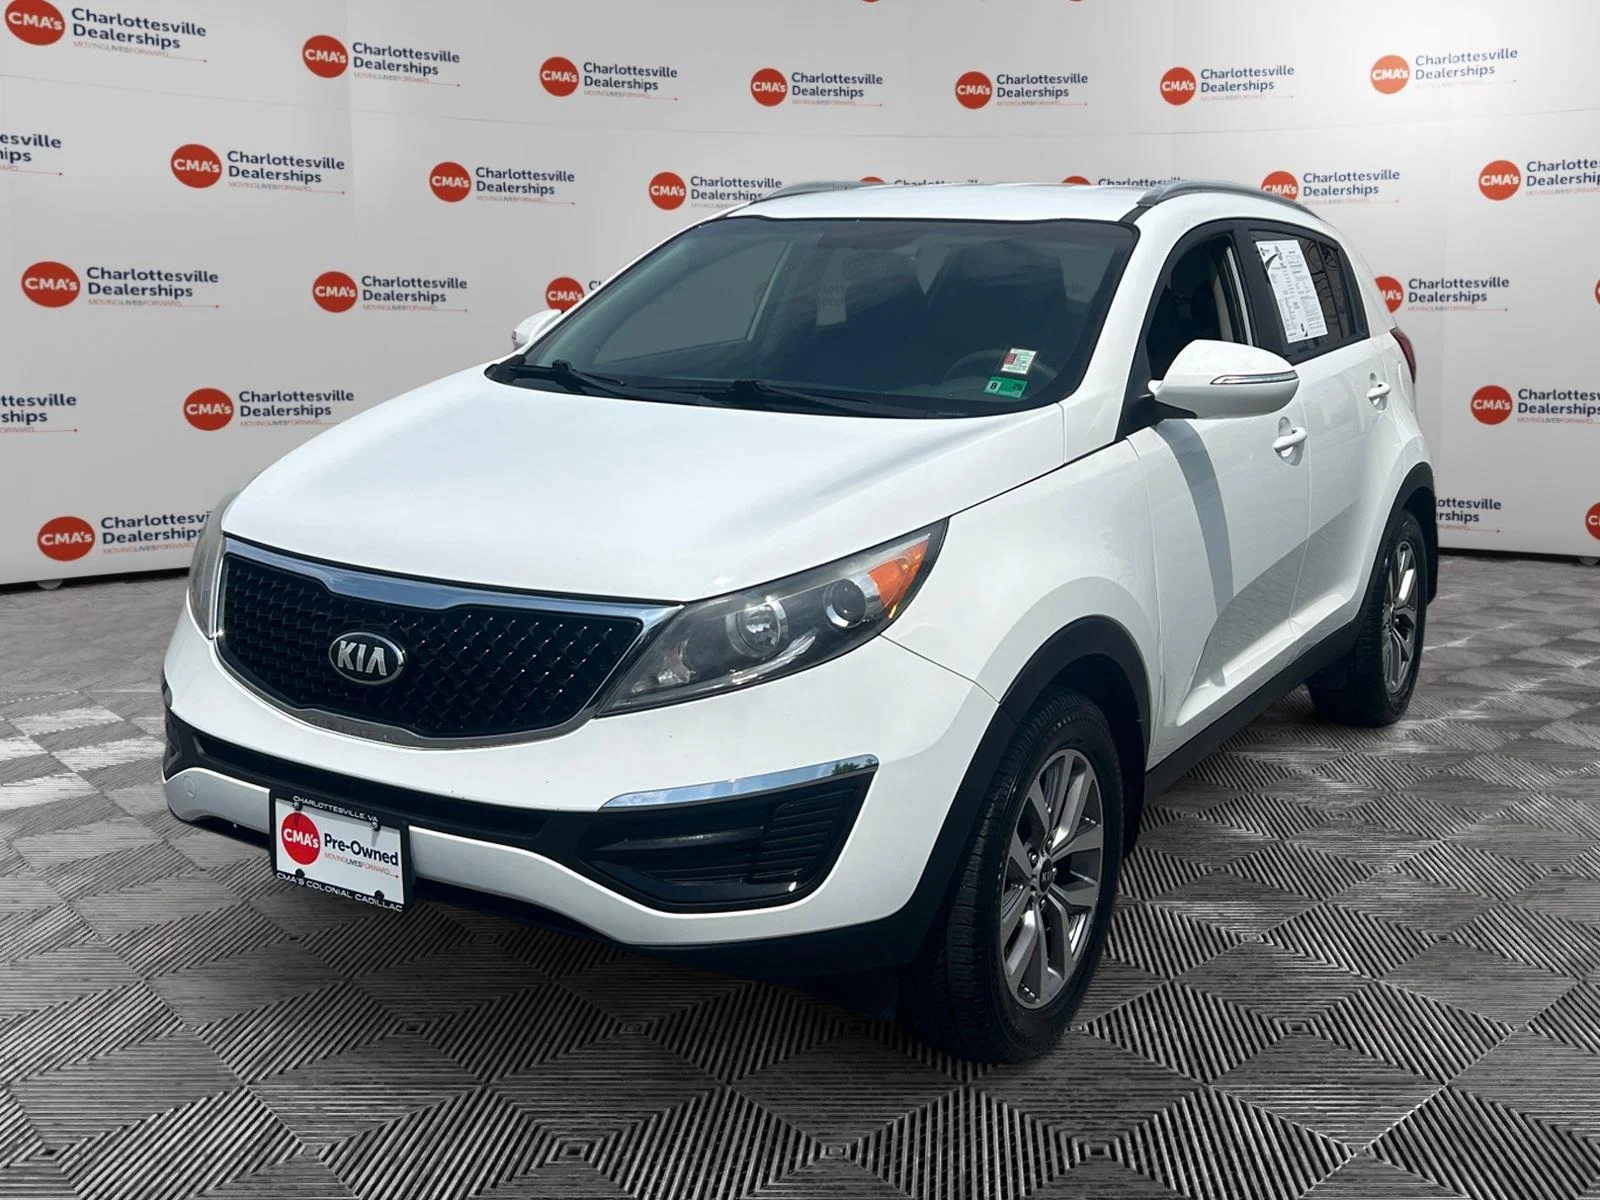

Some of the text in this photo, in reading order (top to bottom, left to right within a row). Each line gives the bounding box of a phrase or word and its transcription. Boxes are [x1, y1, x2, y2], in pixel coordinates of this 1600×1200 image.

[8, 11, 63, 31] CMA's
[71, 7, 207, 37] Charlottesville
[73, 23, 181, 50] Dealerships
[305, 49, 347, 64] CMA's
[352, 42, 460, 63] Charlottesville
[1415, 48, 1518, 66] Charlottesville
[353, 56, 439, 77] Dealerships
[583, 62, 678, 78] Charlottesville
[1200, 65, 1295, 80] Charlottesville
[1415, 65, 1496, 80] Dealerships
[541, 70, 578, 83] CMA's
[791, 72, 884, 85] Charlottesville
[996, 73, 1088, 85] Charlottesville
[1372, 68, 1409, 81] CMA's
[584, 76, 659, 92] Dealerships
[752, 81, 786, 93] CMA's
[957, 85, 992, 96] CMA's
[1161, 80, 1195, 92] CMA's
[1201, 80, 1275, 93] Dealerships
[792, 85, 865, 99] Dealerships
[996, 87, 1069, 99] Dealerships
[173, 158, 220, 173] CMA's
[227, 150, 345, 170] Charlottesville
[1526, 159, 1600, 172] Charlotte
[228, 165, 322, 185] Dealerships
[475, 166, 575, 182] Charlottesville
[1303, 169, 1401, 184] Charlottesville
[1480, 173, 1520, 186] CMA's
[431, 175, 470, 188] CMA's
[476, 180, 555, 197] Dealerships
[690, 175, 783, 189] Charlottesville
[650, 185, 685, 196] CMA's
[1303, 184, 1380, 197] Dealerships
[86, 266, 219, 283] Charlottesville
[25, 277, 78, 291] CMA's
[361, 275, 468, 289] Charlottesville
[1408, 277, 1510, 290] Charlottesville
[88, 282, 193, 300] Dealerships
[315, 286, 356, 298] CMA's
[362, 290, 447, 305] Dealerships
[1408, 291, 1488, 304] Dealerships
[0, 393, 77, 407] ttesville
[239, 390, 354, 404] Charlottesville
[186, 403, 232, 415] CMA's
[240, 405, 332, 418] Dealerships
[1472, 399, 1511, 410] CMA's
[41, 531, 92, 546] CMA's
[338, 640, 387, 676] KIA
[284, 828, 319, 849] CMA's
[324, 833, 399, 866] Pre-Owned
[307, 880, 353, 898] COLONIAL
[355, 893, 403, 912] CADILLAC
